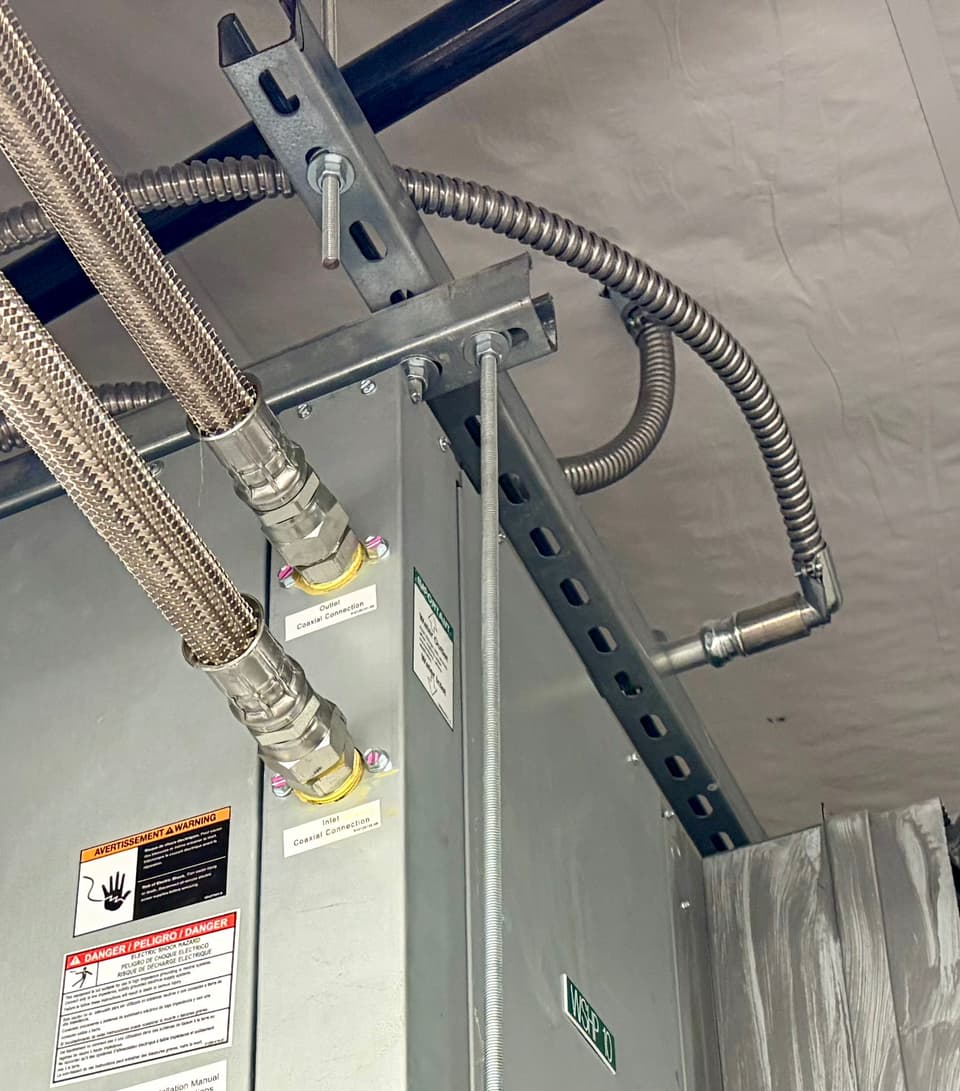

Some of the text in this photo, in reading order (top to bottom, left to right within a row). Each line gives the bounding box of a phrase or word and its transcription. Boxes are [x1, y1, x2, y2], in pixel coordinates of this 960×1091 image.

[296, 616, 323, 630] Coaxial
[324, 601, 365, 620] Connection
[319, 600, 340, 611] Outlet
[94, 829, 165, 856] AVERTISSEMENT
[175, 814, 216, 832] WARNING
[294, 832, 323, 846] Coaxial
[325, 817, 370, 836] Connection
[322, 816, 339, 826] Inlet
[84, 944, 125, 962] DANGER
[133, 930, 177, 950] PELIGRO
[185, 918, 228, 937] DANGER
[190, 1074, 219, 1087] Manual
